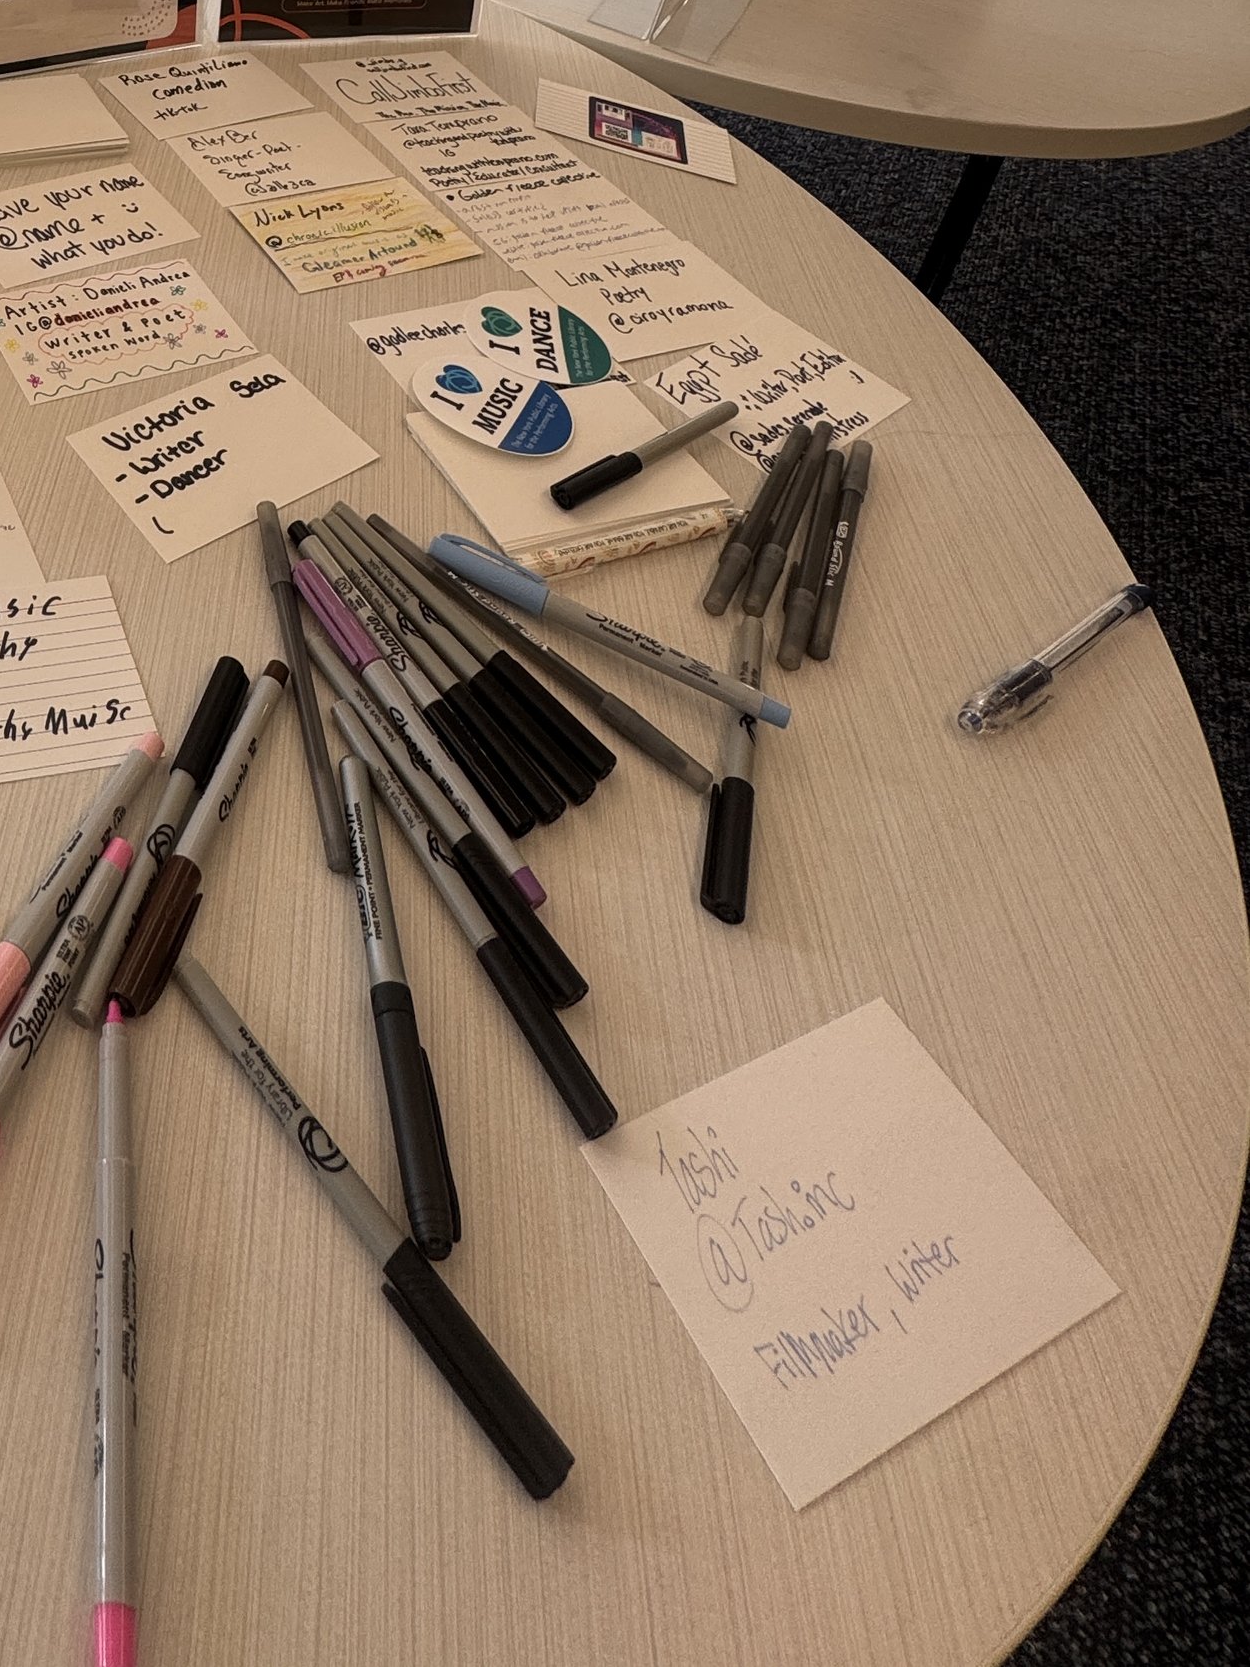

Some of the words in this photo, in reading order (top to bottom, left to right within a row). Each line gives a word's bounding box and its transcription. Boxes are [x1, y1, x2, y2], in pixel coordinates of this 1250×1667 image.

[44, 185, 93, 210] your
[83, 281, 137, 300] Danieli
[139, 270, 191, 289] Andrea
[555, 269, 603, 287] Lina
[603, 259, 686, 279] Montenegro
[489, 340, 521, 355] I
[529, 307, 559, 374] DANCE
[656, 354, 722, 405] Egypt
[430, 391, 464, 411] I
[472, 378, 524, 435] MUSIC
[101, 395, 216, 452] Victoria
[9, 971, 68, 1071] Sharpie
